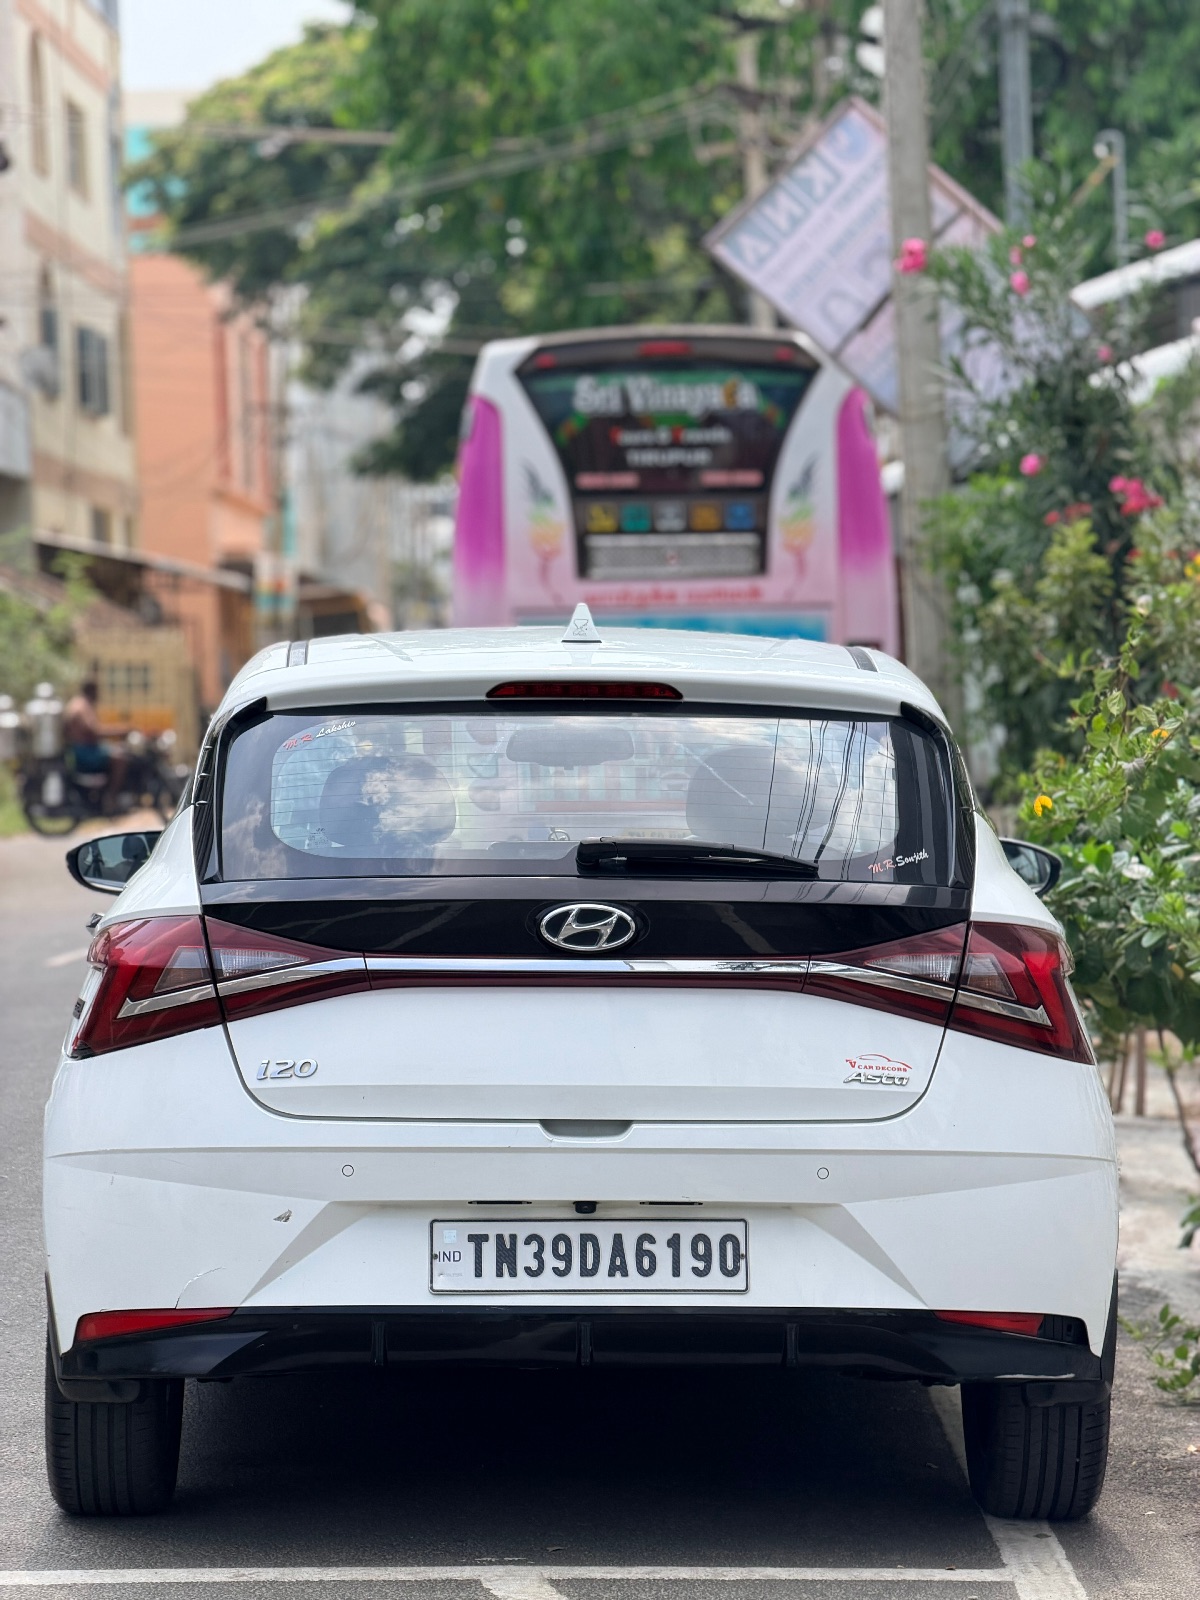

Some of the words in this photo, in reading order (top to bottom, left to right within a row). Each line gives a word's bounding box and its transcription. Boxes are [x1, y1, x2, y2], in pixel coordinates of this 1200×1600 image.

[843, 1072, 910, 1087] Asta
[438, 1250, 462, 1263] IND
[467, 1232, 741, 1278] TN39DA6190
